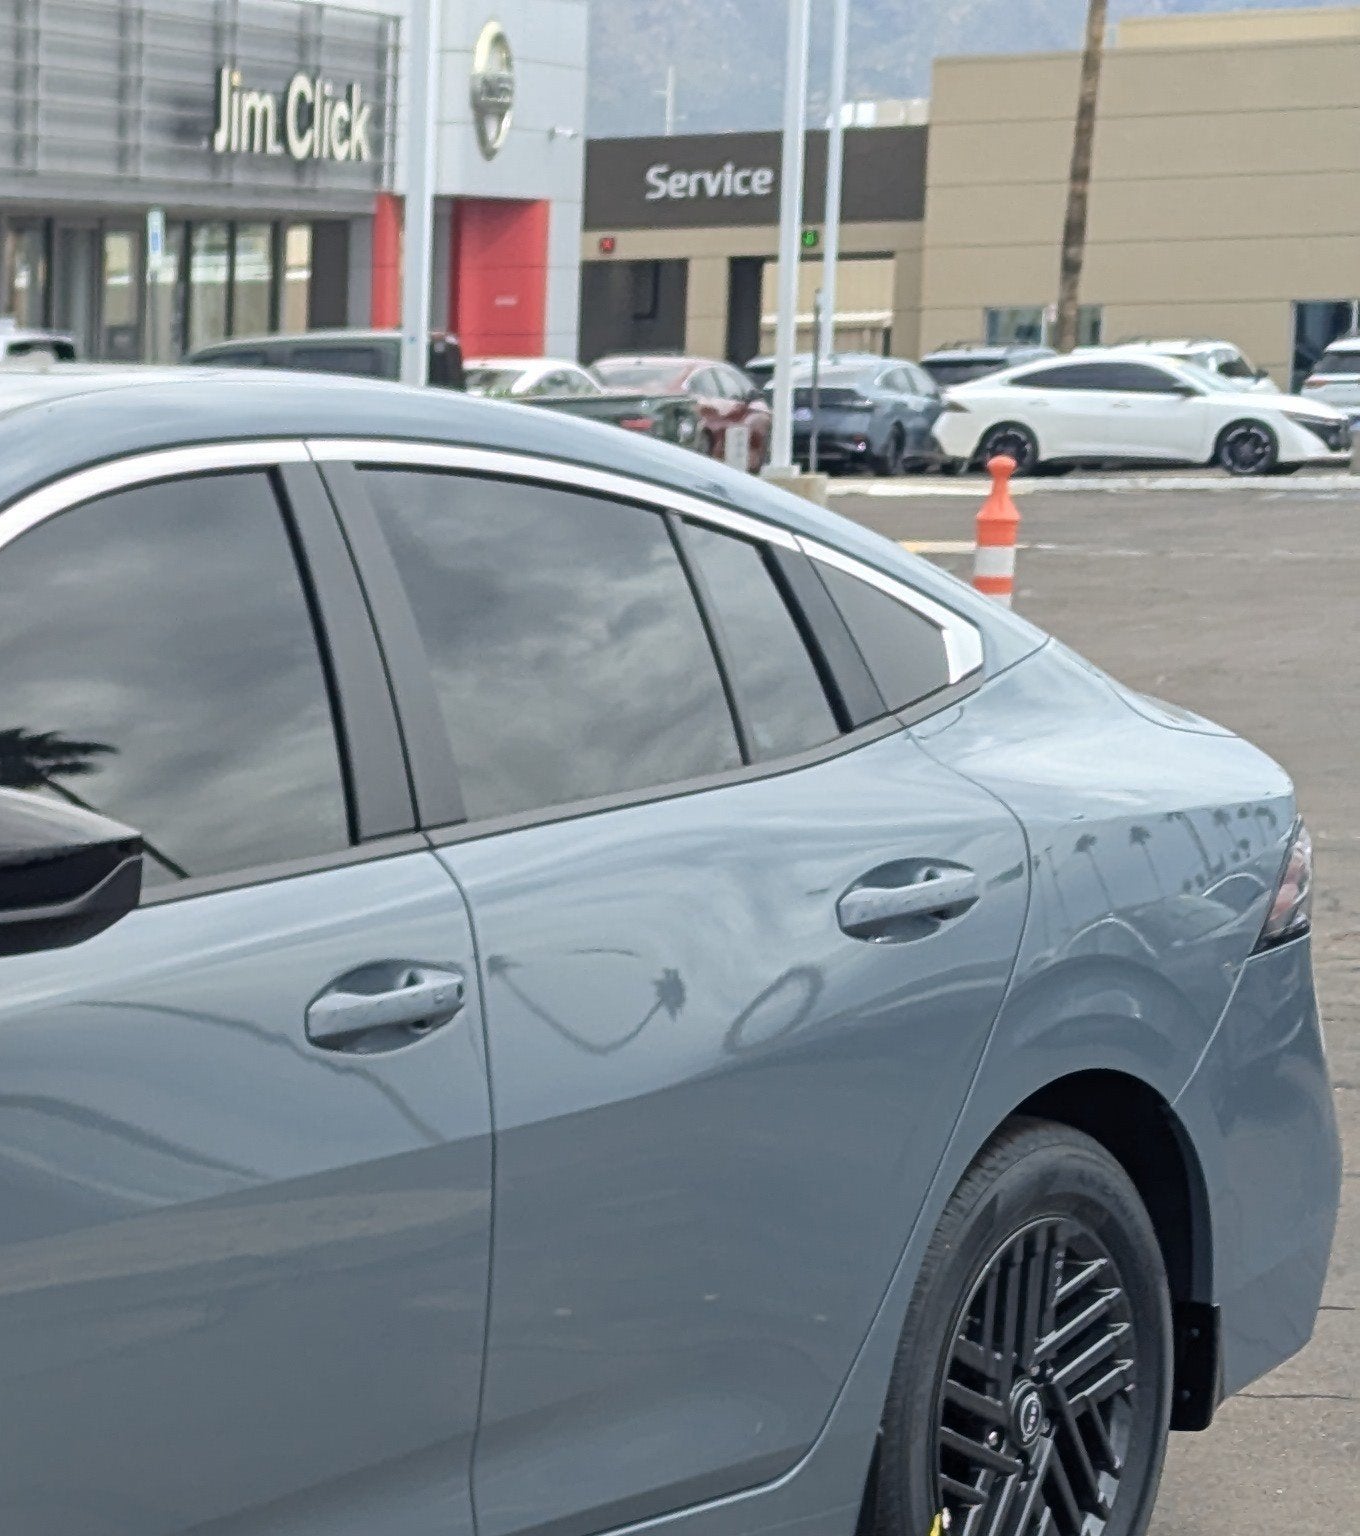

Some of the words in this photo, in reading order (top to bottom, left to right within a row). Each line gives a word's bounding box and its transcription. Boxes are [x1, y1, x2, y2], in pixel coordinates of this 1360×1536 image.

[214, 65, 279, 154] Jim
[286, 72, 372, 163] Click
[644, 160, 775, 200] Service
